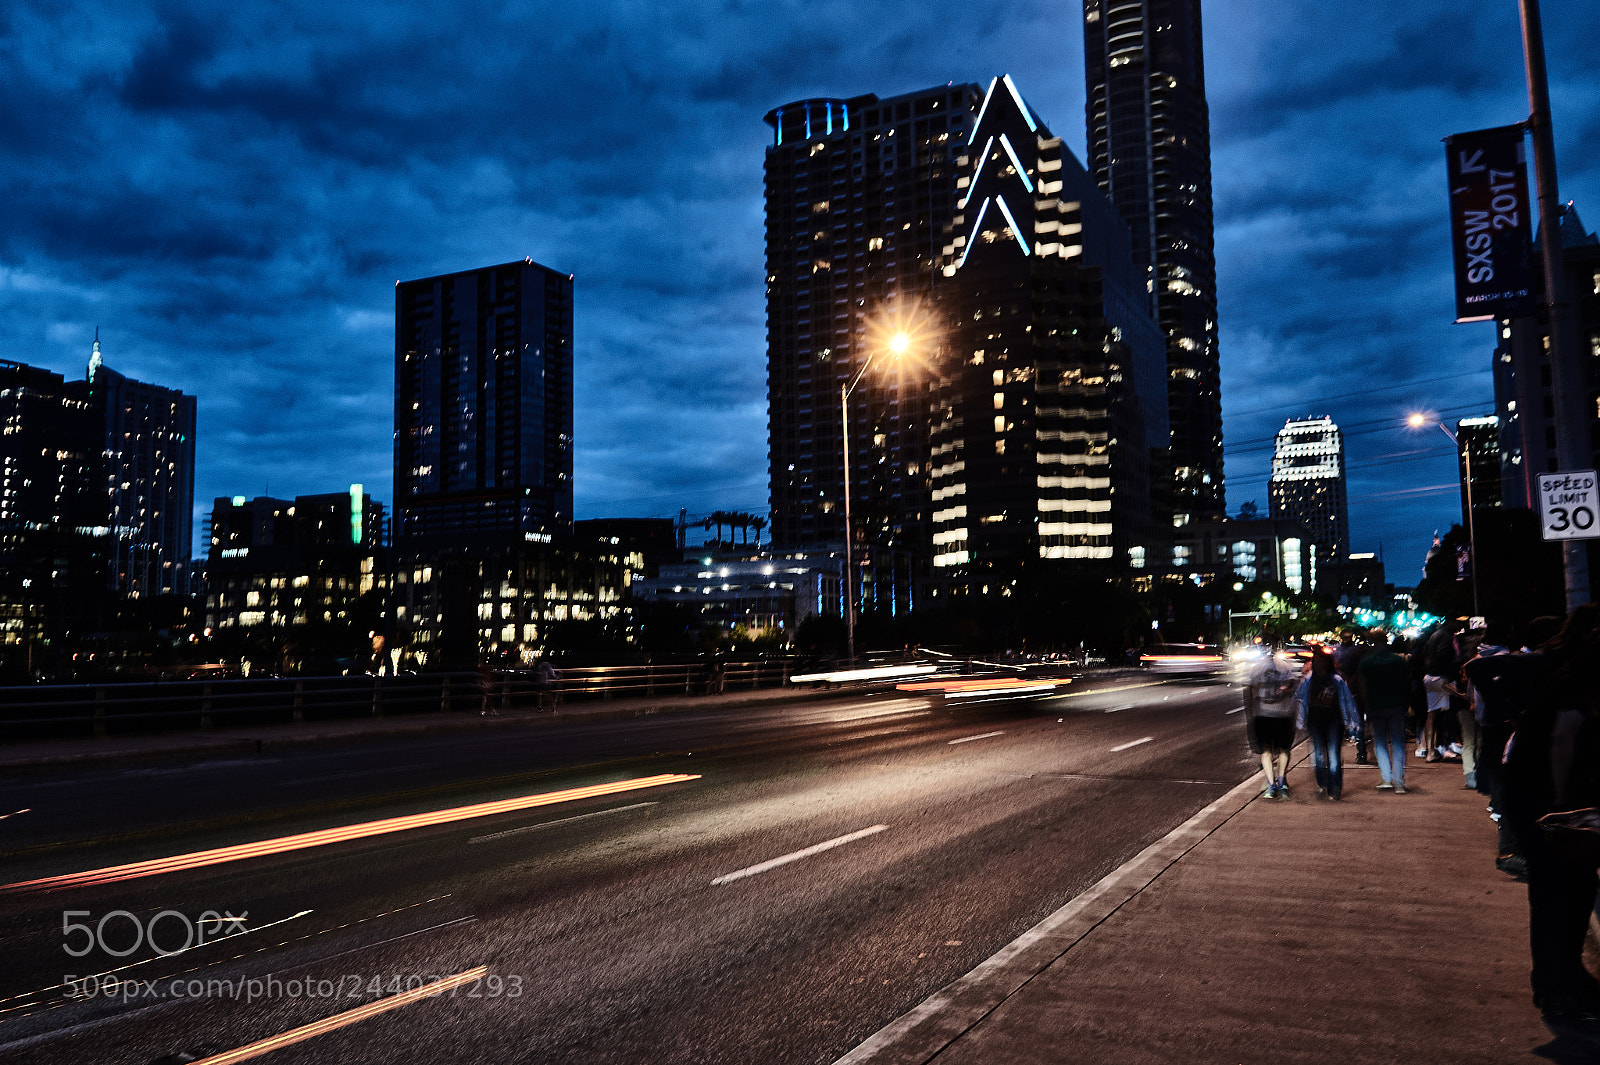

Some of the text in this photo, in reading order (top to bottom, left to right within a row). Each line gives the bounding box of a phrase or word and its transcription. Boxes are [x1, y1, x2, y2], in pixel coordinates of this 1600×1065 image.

[1489, 169, 1519, 229] 2017
[1464, 210, 1494, 284] SXSW
[1543, 478, 1594, 491] SPEED
[1549, 492, 1589, 505] LIMIT
[1549, 506, 1594, 531] 30
